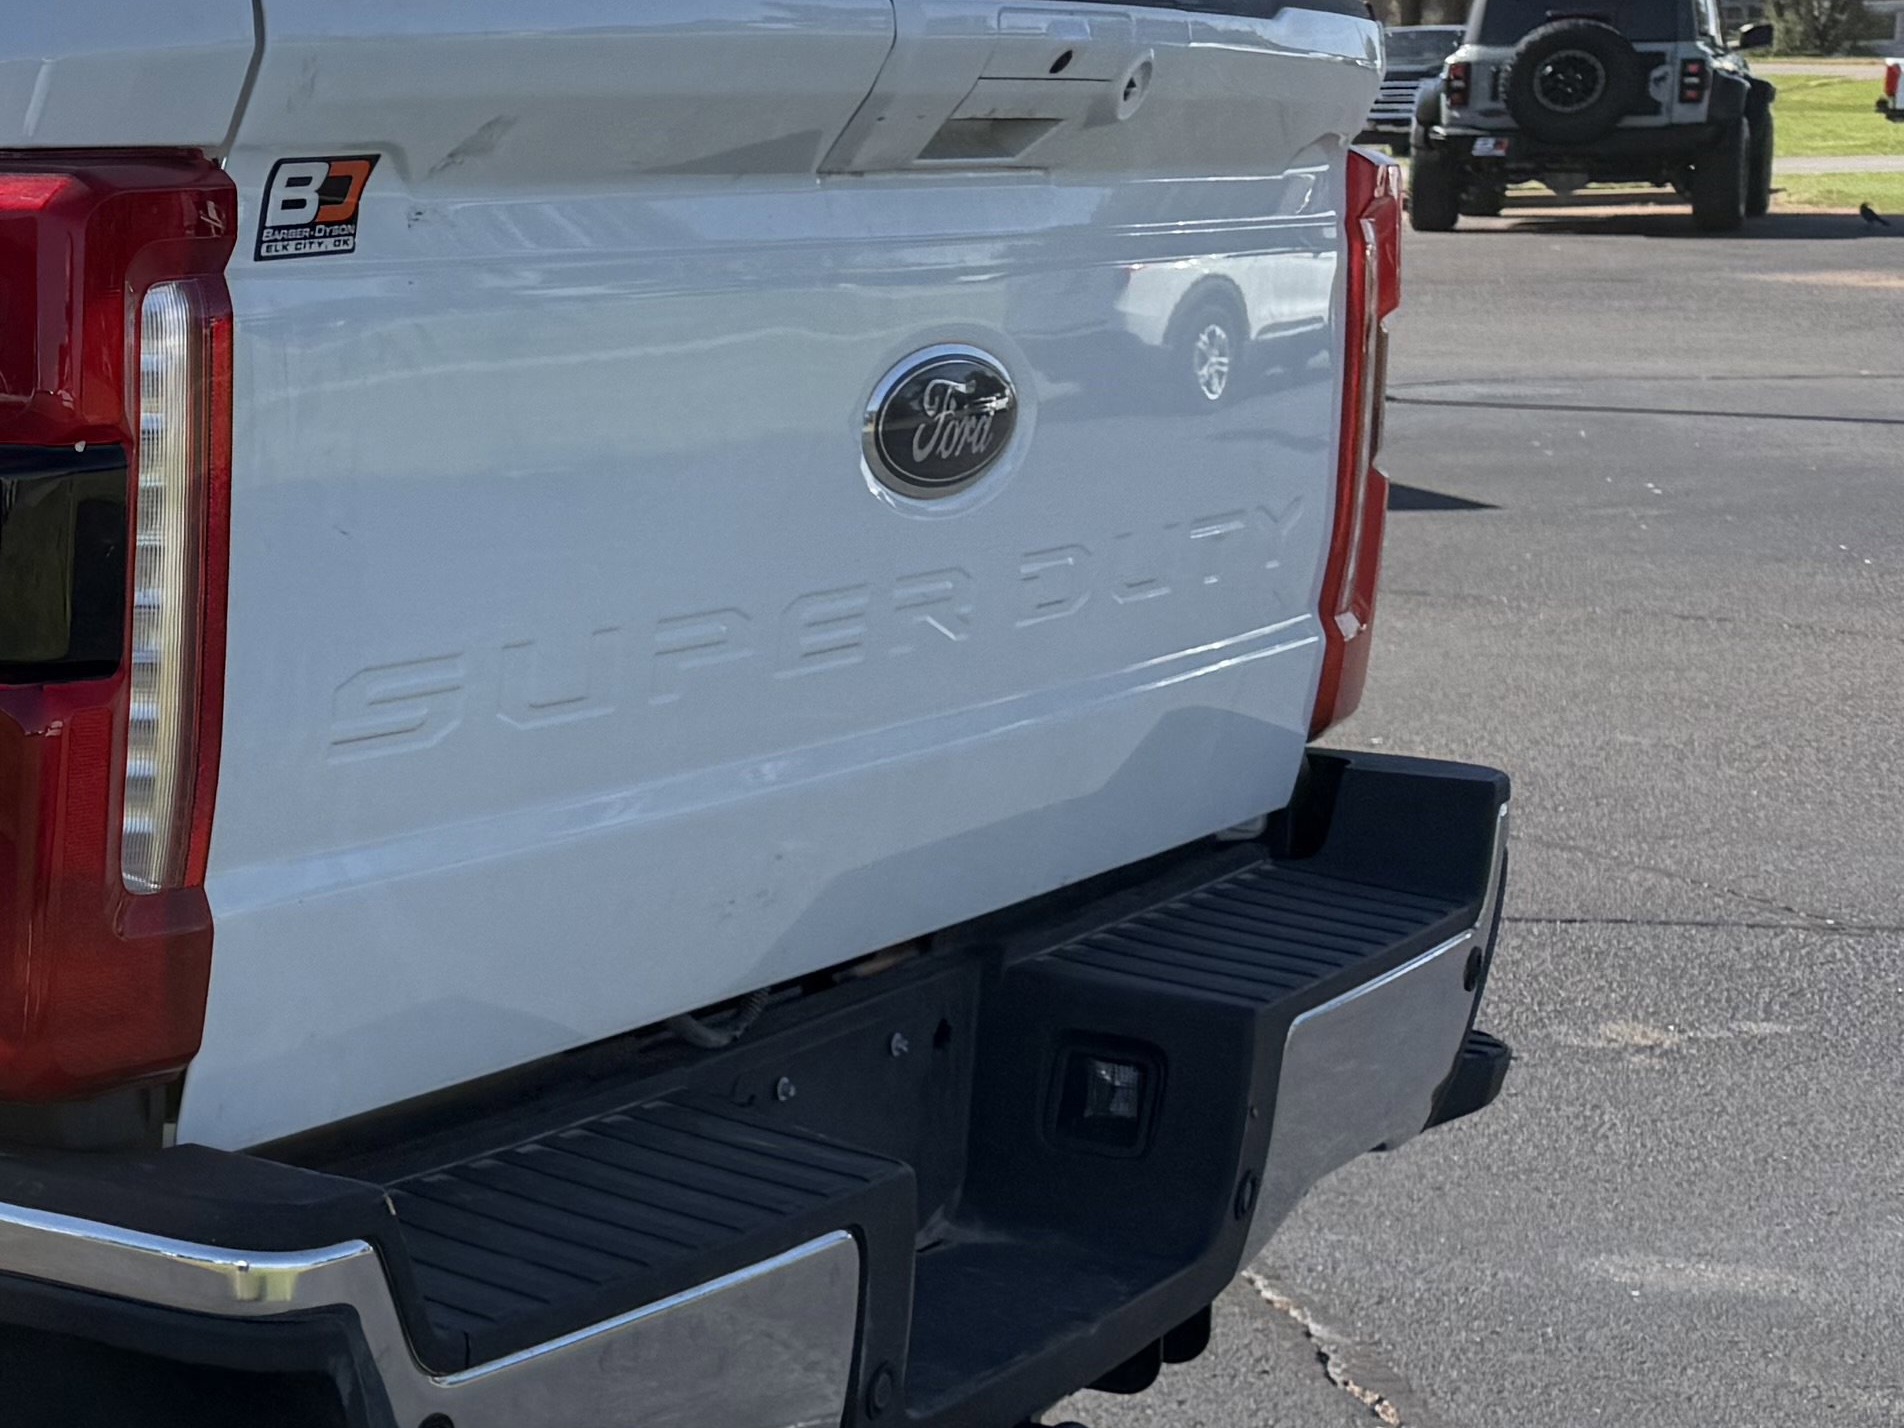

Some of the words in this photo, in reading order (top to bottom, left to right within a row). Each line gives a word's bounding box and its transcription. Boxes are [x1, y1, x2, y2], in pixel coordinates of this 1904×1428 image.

[265, 243, 289, 254] ELK
[333, 238, 350, 248] OK
[912, 379, 998, 462] Ford
[328, 564, 973, 766] SUPER
